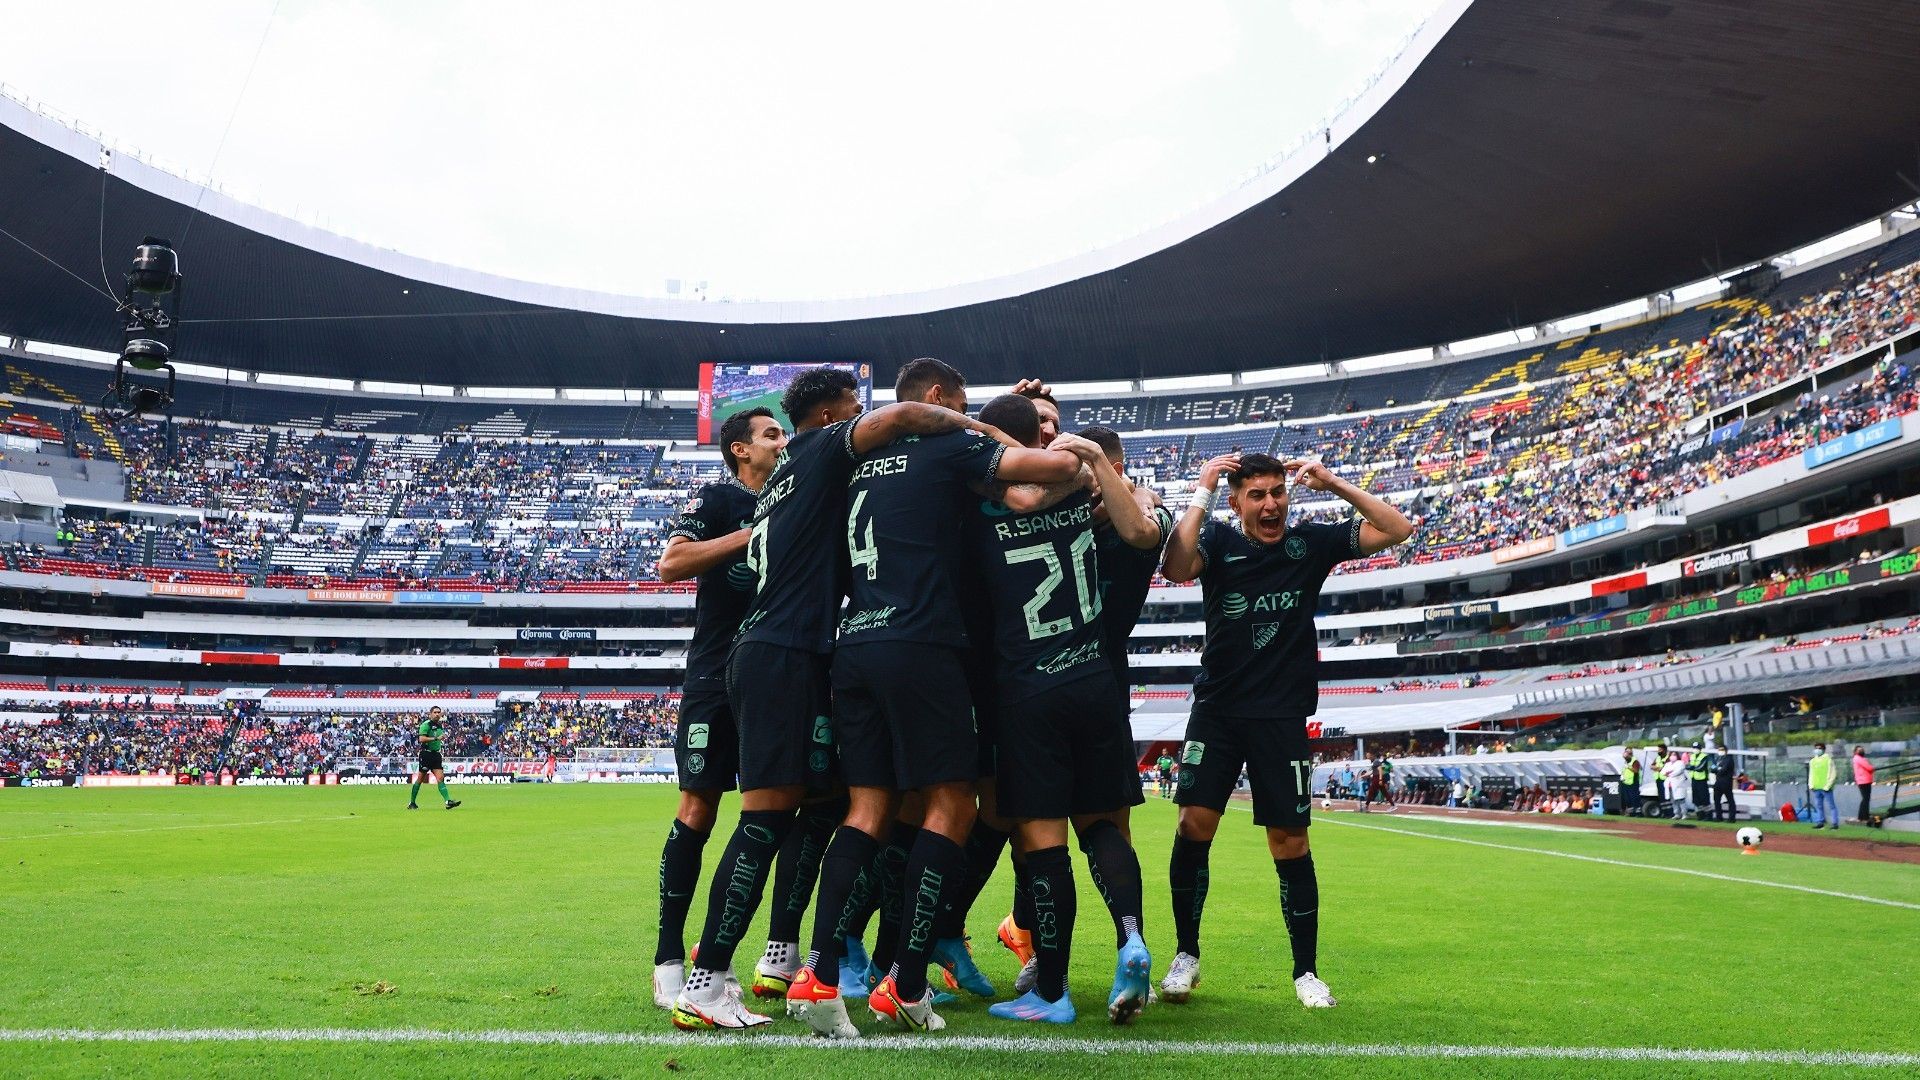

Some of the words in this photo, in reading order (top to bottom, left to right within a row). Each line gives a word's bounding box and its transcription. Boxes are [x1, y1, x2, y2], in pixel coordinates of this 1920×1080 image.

[1074, 405, 1138, 426] CON
[848, 490, 879, 580] 4
[1694, 549, 1749, 572] caliente.mx
[159, 584, 178, 593] THE
[181, 585, 208, 594] HOME
[209, 587, 240, 596] DEPOT
[1004, 528, 1103, 640] 20
[1254, 590, 1303, 611] AT&T
[1425, 608, 1455, 621] Corona
[1461, 603, 1492, 617] Corona
[521, 629, 553, 640] Corona
[560, 629, 591, 640] Corona
[524, 659, 547, 668] Coca-Cola
[32, 778, 63, 787] Steren
[236, 775, 305, 786] caliente.mx
[340, 774, 408, 785] caliente.mx
[445, 773, 512, 784] caliente.mx
